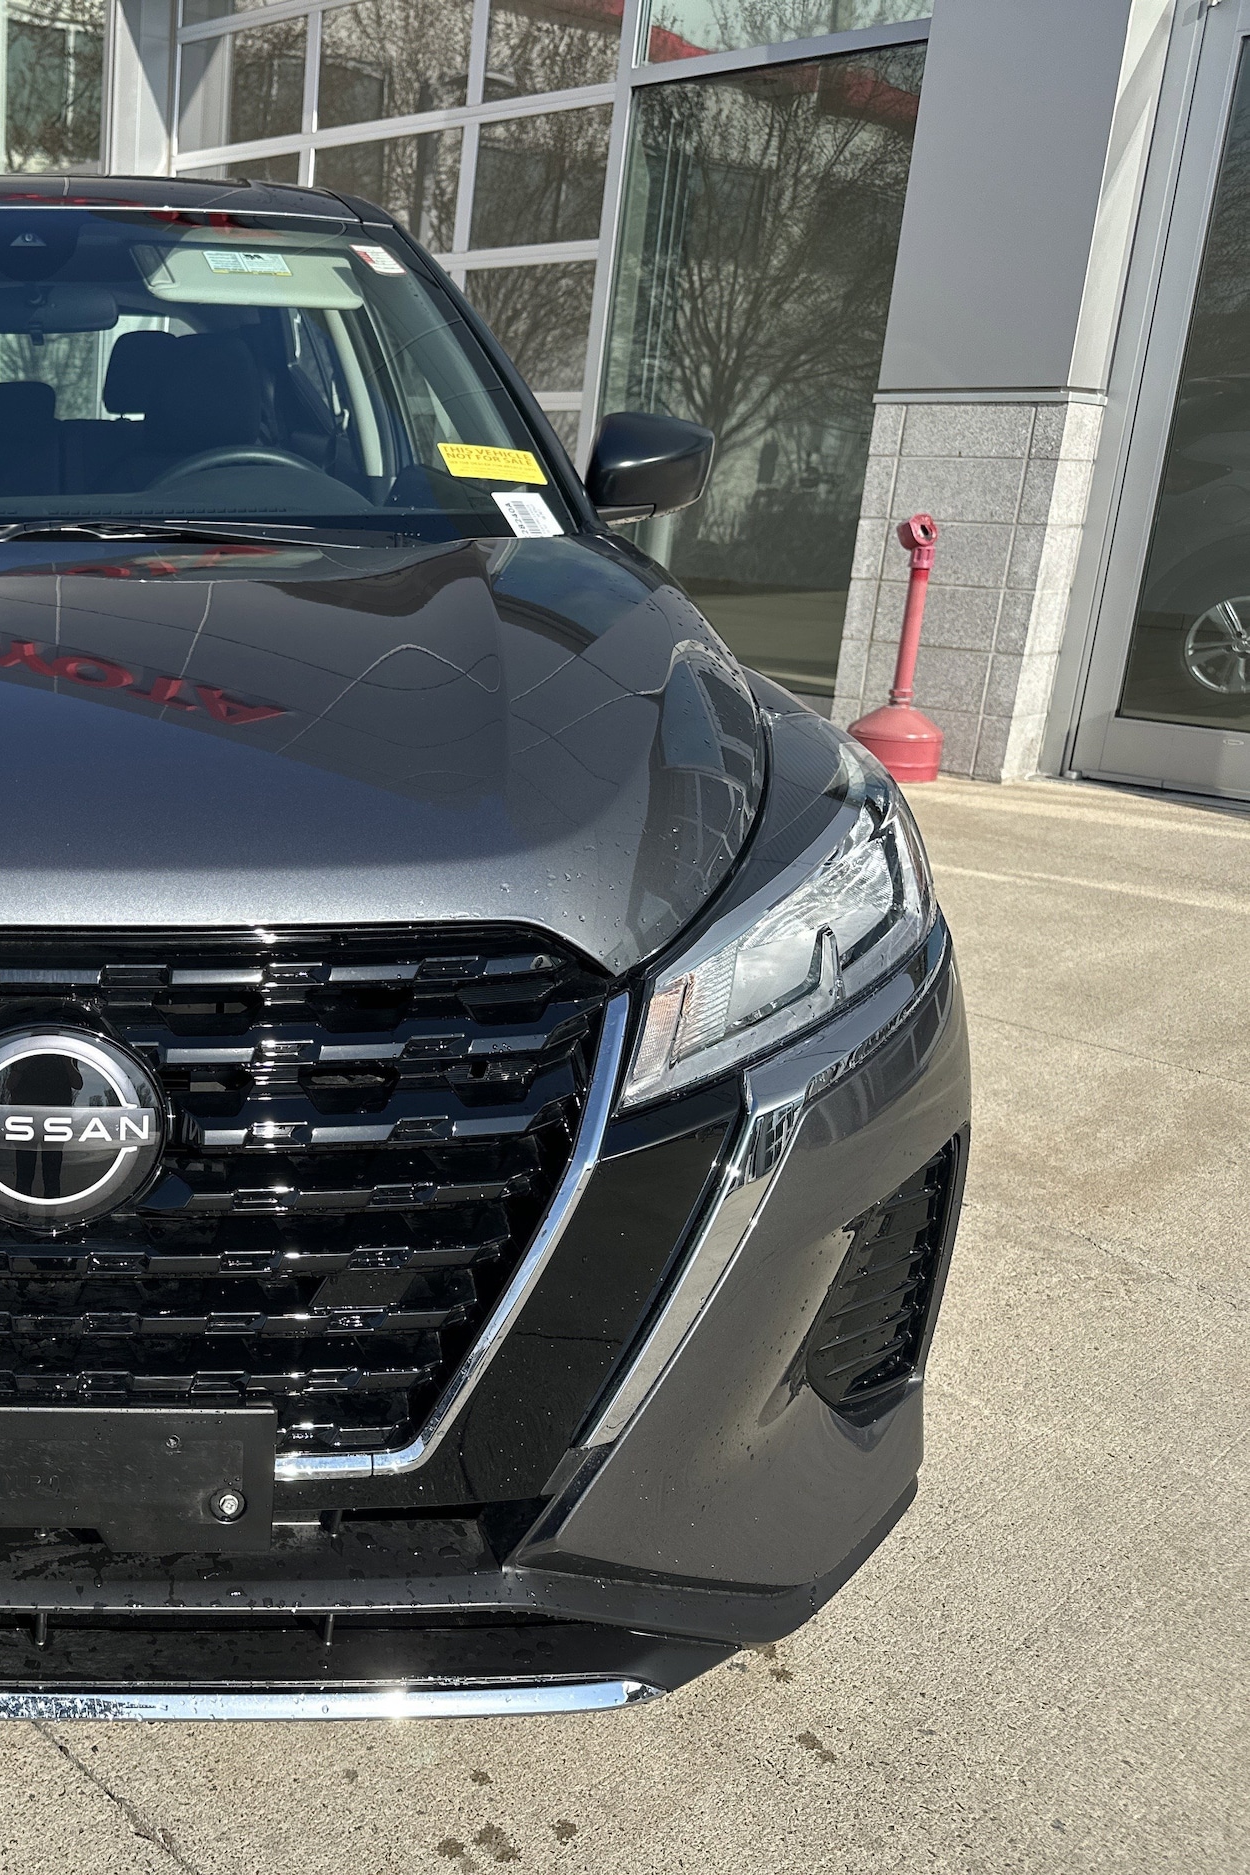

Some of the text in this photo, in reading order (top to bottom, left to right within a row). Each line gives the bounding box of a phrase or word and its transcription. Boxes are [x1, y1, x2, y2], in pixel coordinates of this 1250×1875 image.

[443, 446, 531, 461] THIS VEHICLE
[475, 454, 500, 462] FOR
[503, 457, 533, 466] SALE
